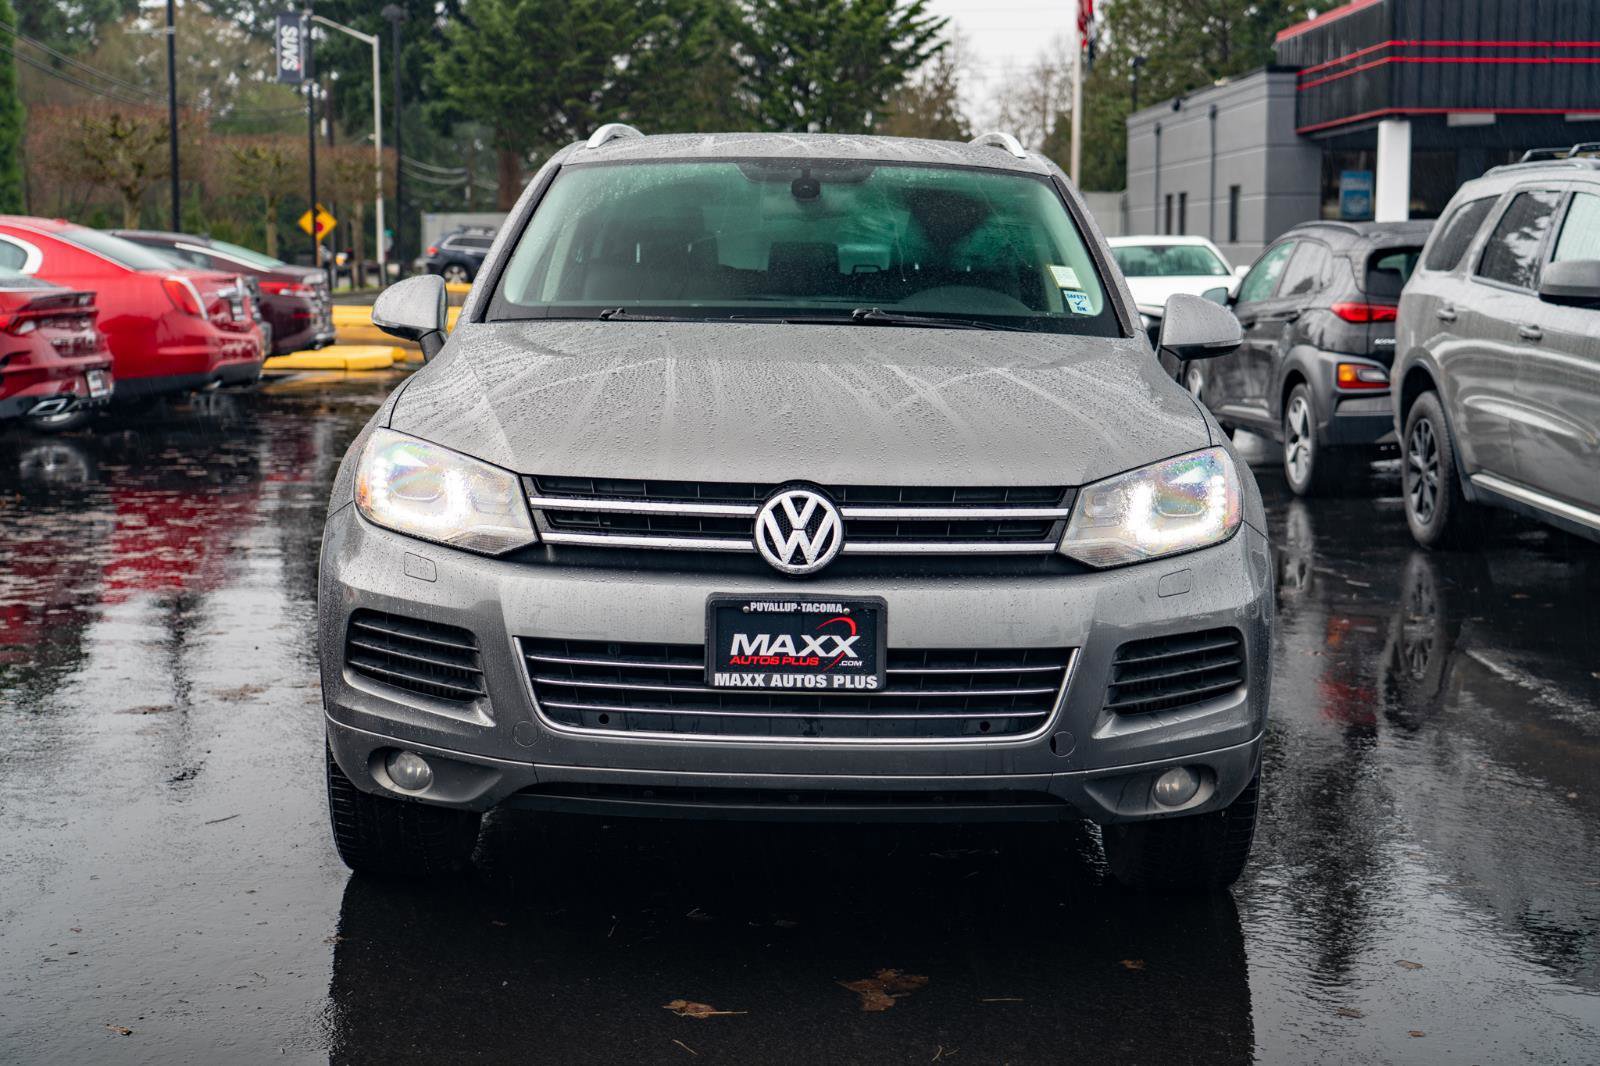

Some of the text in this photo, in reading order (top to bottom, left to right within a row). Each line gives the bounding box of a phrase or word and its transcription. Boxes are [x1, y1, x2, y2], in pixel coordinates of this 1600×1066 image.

[730, 633, 861, 657] MAXX
[730, 656, 780, 665] AUTOS
[782, 656, 820, 666] PLUS
[714, 673, 878, 689] MAXX AUTOS PLUS
